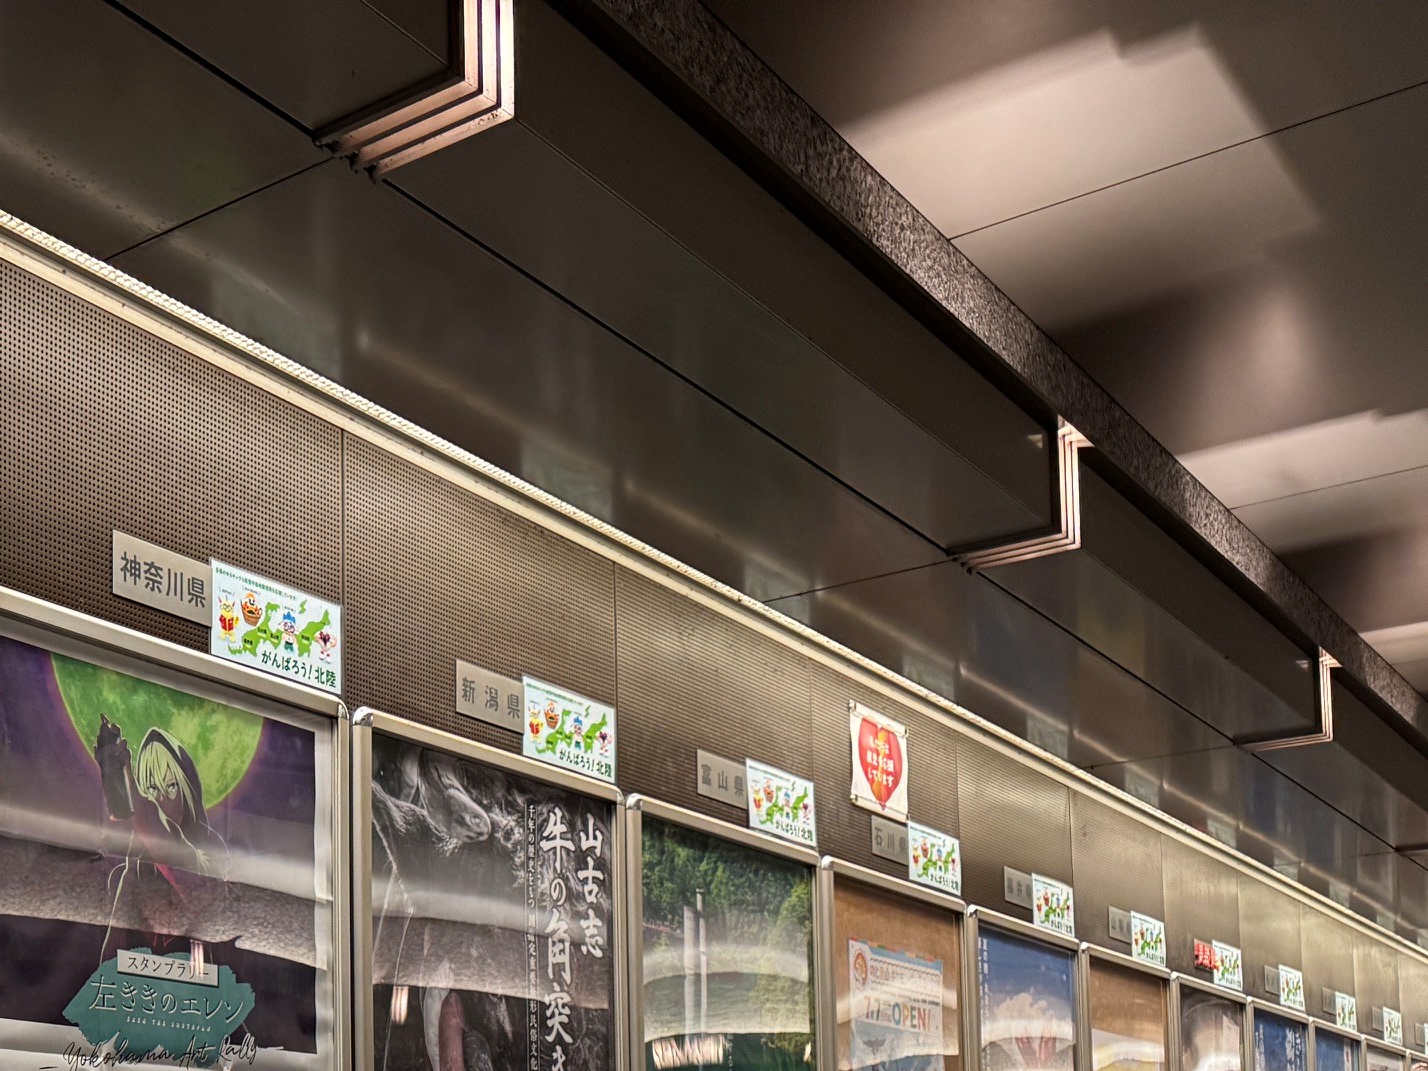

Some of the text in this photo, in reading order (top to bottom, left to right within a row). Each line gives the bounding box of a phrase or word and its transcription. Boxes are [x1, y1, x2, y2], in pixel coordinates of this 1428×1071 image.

[120, 550, 206, 609] 神奈川県
[461, 676, 521, 720] 新潟県
[701, 762, 744, 799] 富山県
[577, 812, 605, 958] 山古志
[128, 956, 210, 980] スタンプラリー
[88, 974, 244, 1024] 左ききのエレン
